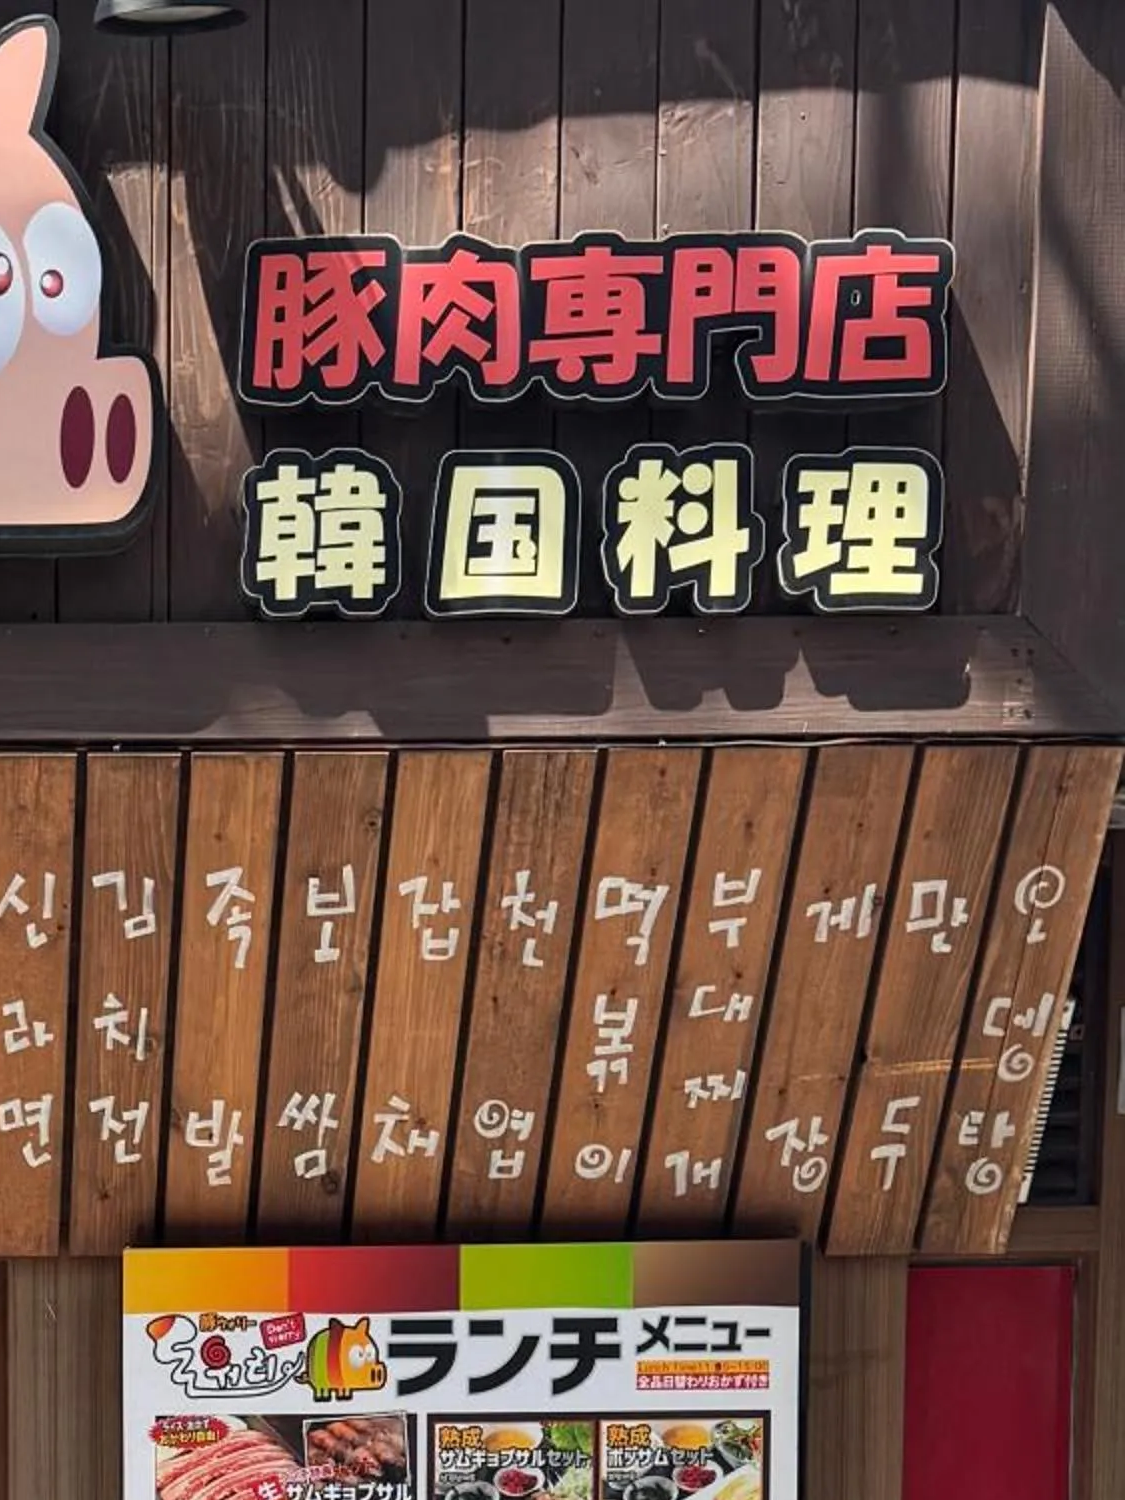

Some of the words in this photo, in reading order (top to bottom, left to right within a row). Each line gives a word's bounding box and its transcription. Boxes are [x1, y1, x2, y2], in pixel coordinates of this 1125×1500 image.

[253, 245, 939, 390] 豚肉専門店
[255, 459, 929, 602] 韓国料理
[90, 870, 156, 1165] 김치전
[185, 867, 256, 1186] 족발
[278, 864, 355, 1179] 보쌈
[371, 875, 461, 1163] 잡채
[474, 870, 558, 1180] 천엽
[575, 877, 669, 1182] 떡볶이
[666, 868, 761, 1196] 부대찌개
[766, 883, 876, 1193] 게장
[871, 879, 968, 1190] 만두
[959, 865, 1074, 1195] 오뎅탕
[387, 1317, 621, 1397] ランチ
[636, 1316, 771, 1353] メニュー
[440, 1426, 483, 1449] 熟成
[607, 1425, 651, 1448] 熟成
[636, 1375, 770, 1389] 全品日替わりおかず付き
